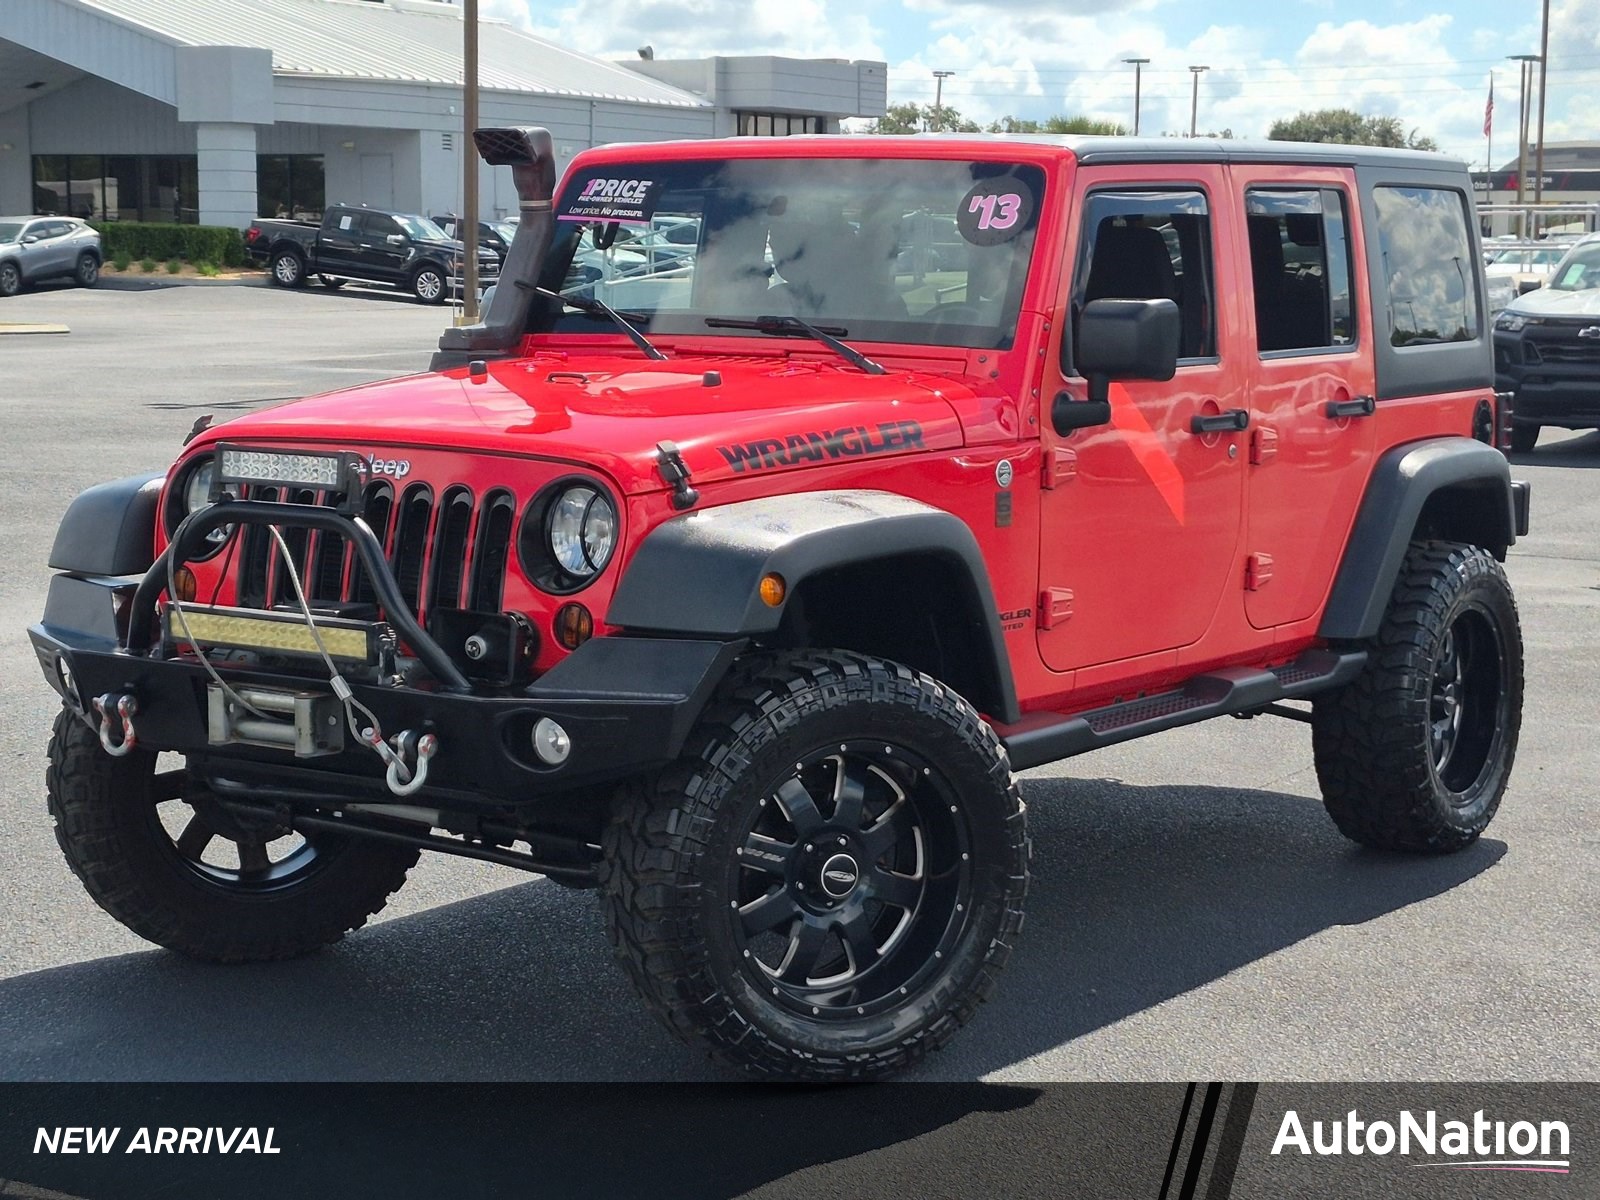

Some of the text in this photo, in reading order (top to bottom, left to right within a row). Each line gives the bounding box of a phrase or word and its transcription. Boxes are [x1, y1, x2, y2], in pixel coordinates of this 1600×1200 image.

[568, 205, 582, 214] Low
[600, 207, 611, 215] No
[611, 208, 643, 217] pressure.
[613, 197, 643, 205] VEHICLES
[968, 193, 1021, 230] '13
[716, 420, 924, 473] WRANGLER
